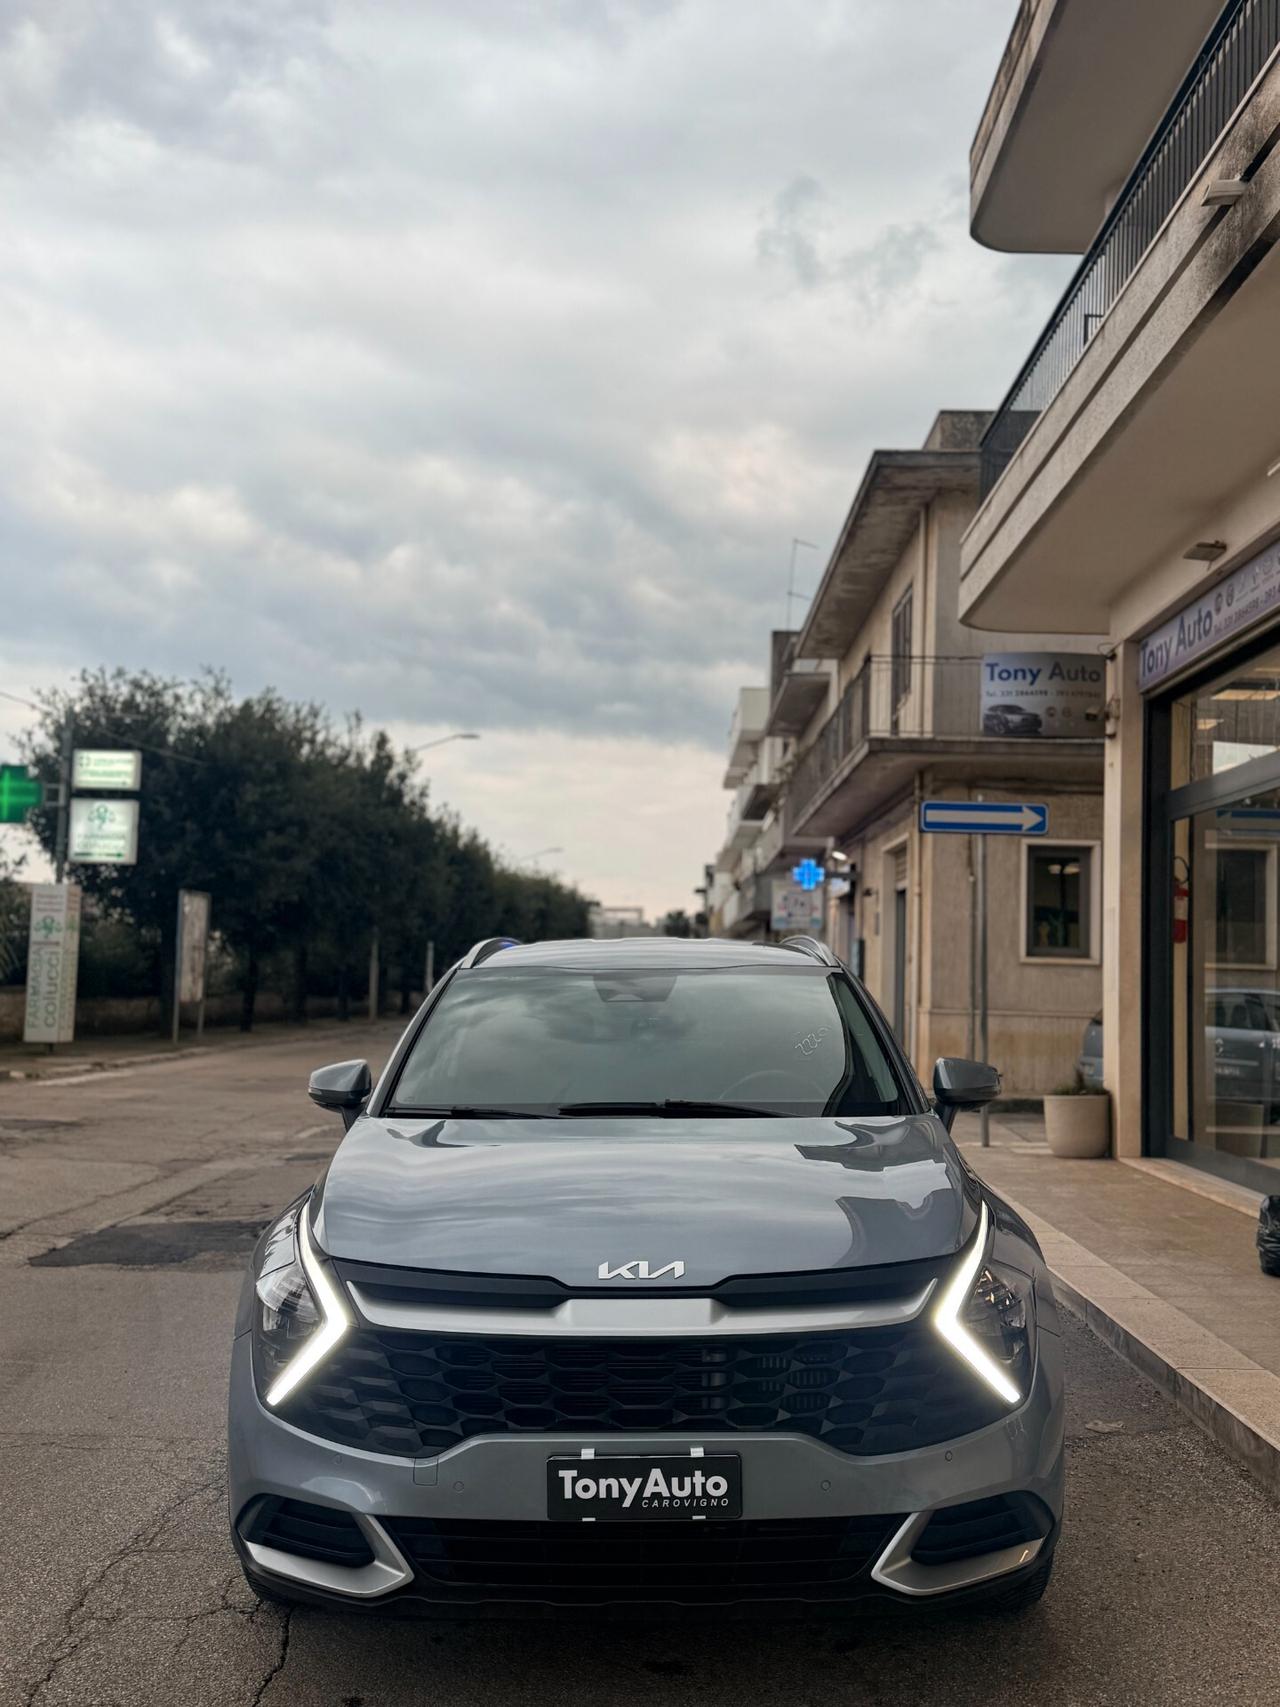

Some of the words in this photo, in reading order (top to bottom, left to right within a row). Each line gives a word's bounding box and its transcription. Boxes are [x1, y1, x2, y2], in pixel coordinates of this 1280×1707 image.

[1140, 637, 1173, 677] Tony
[1176, 608, 1213, 656] Auto
[985, 662, 1042, 686] Tony
[1048, 661, 1101, 682] Auto
[27, 947, 47, 1029] FARMACIA
[44, 949, 60, 1028] colucci
[598, 1260, 684, 1279] KIA
[558, 1468, 728, 1508] TonyAuto
[641, 1498, 729, 1508] CAROVIGNO
